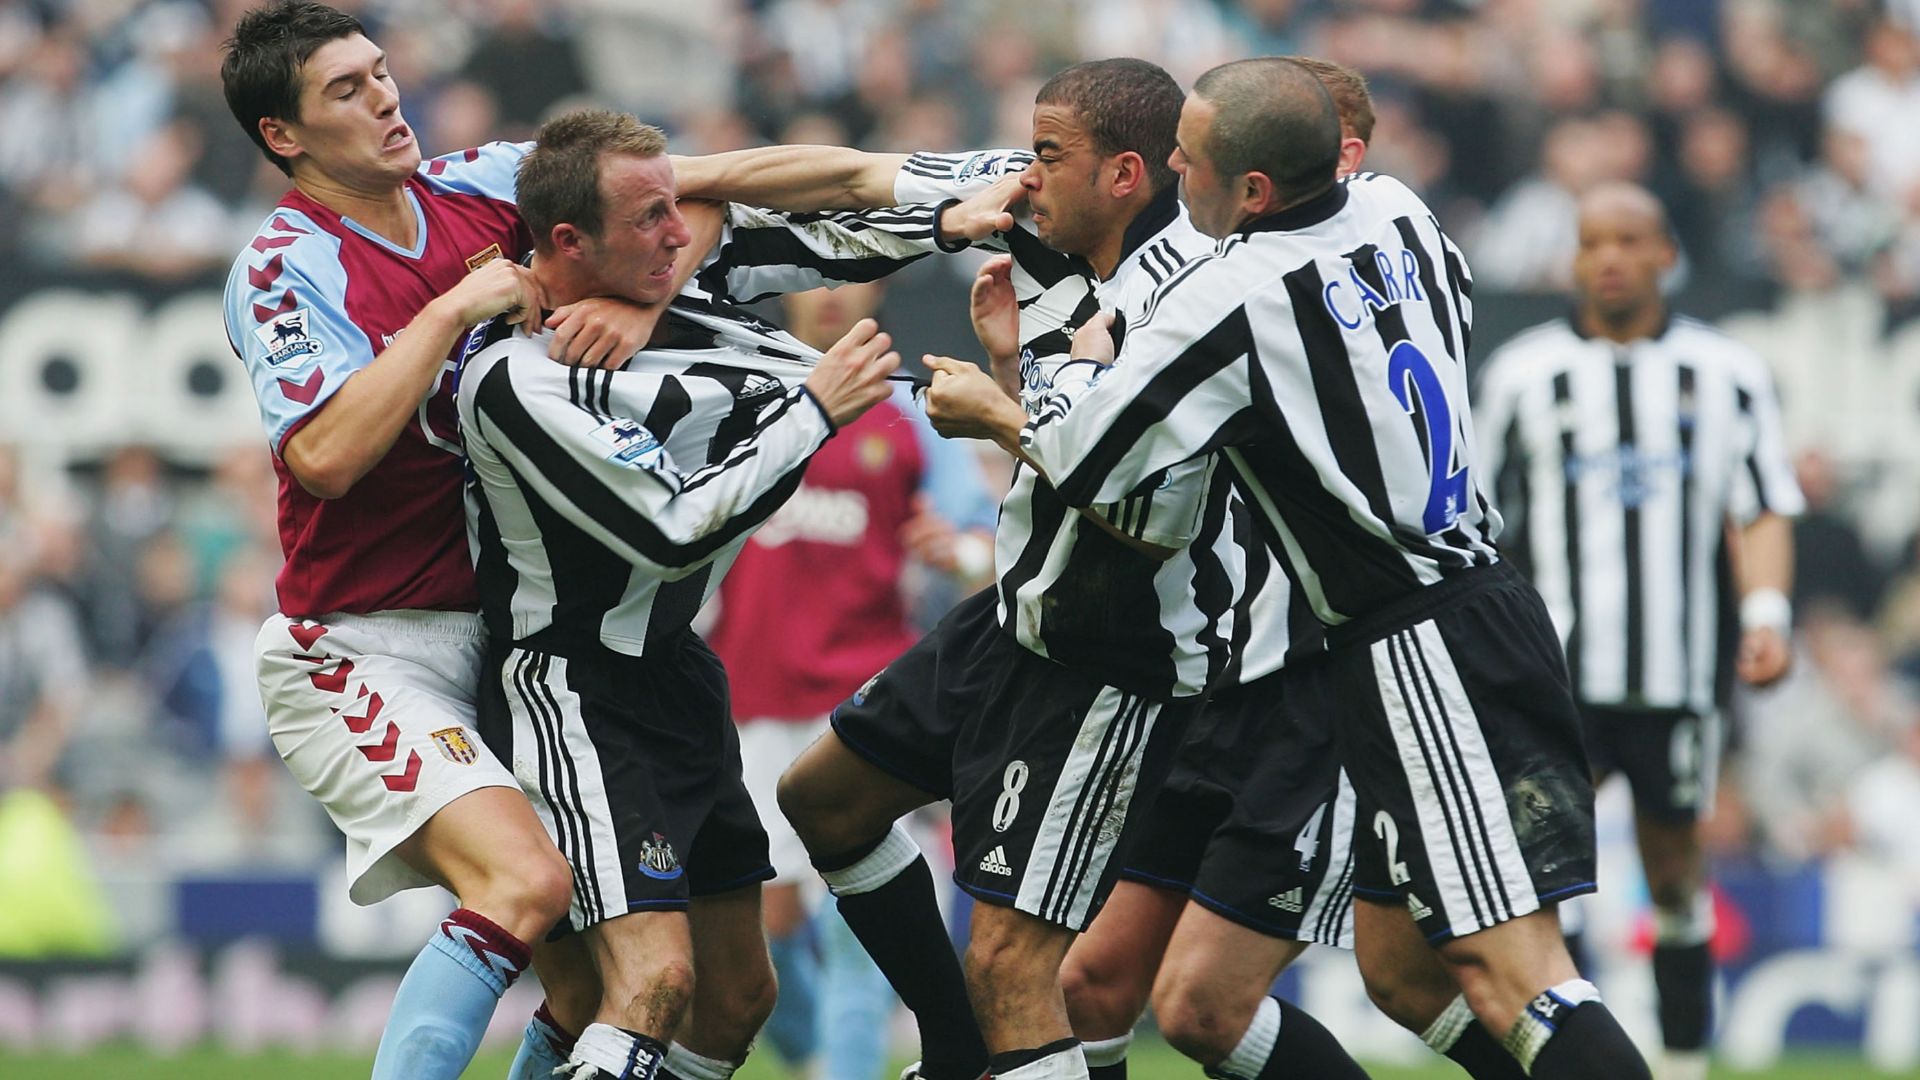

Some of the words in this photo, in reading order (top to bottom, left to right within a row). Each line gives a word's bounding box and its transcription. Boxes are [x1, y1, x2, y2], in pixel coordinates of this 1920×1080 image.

[1324, 250, 1423, 330] CARR
[271, 343, 308, 361] BARCLAYS
[1388, 340, 1468, 535] 2
[992, 760, 1029, 832] 8
[980, 861, 1012, 876] adidas
[1294, 802, 1328, 872] 4
[1373, 810, 1411, 886] 2
